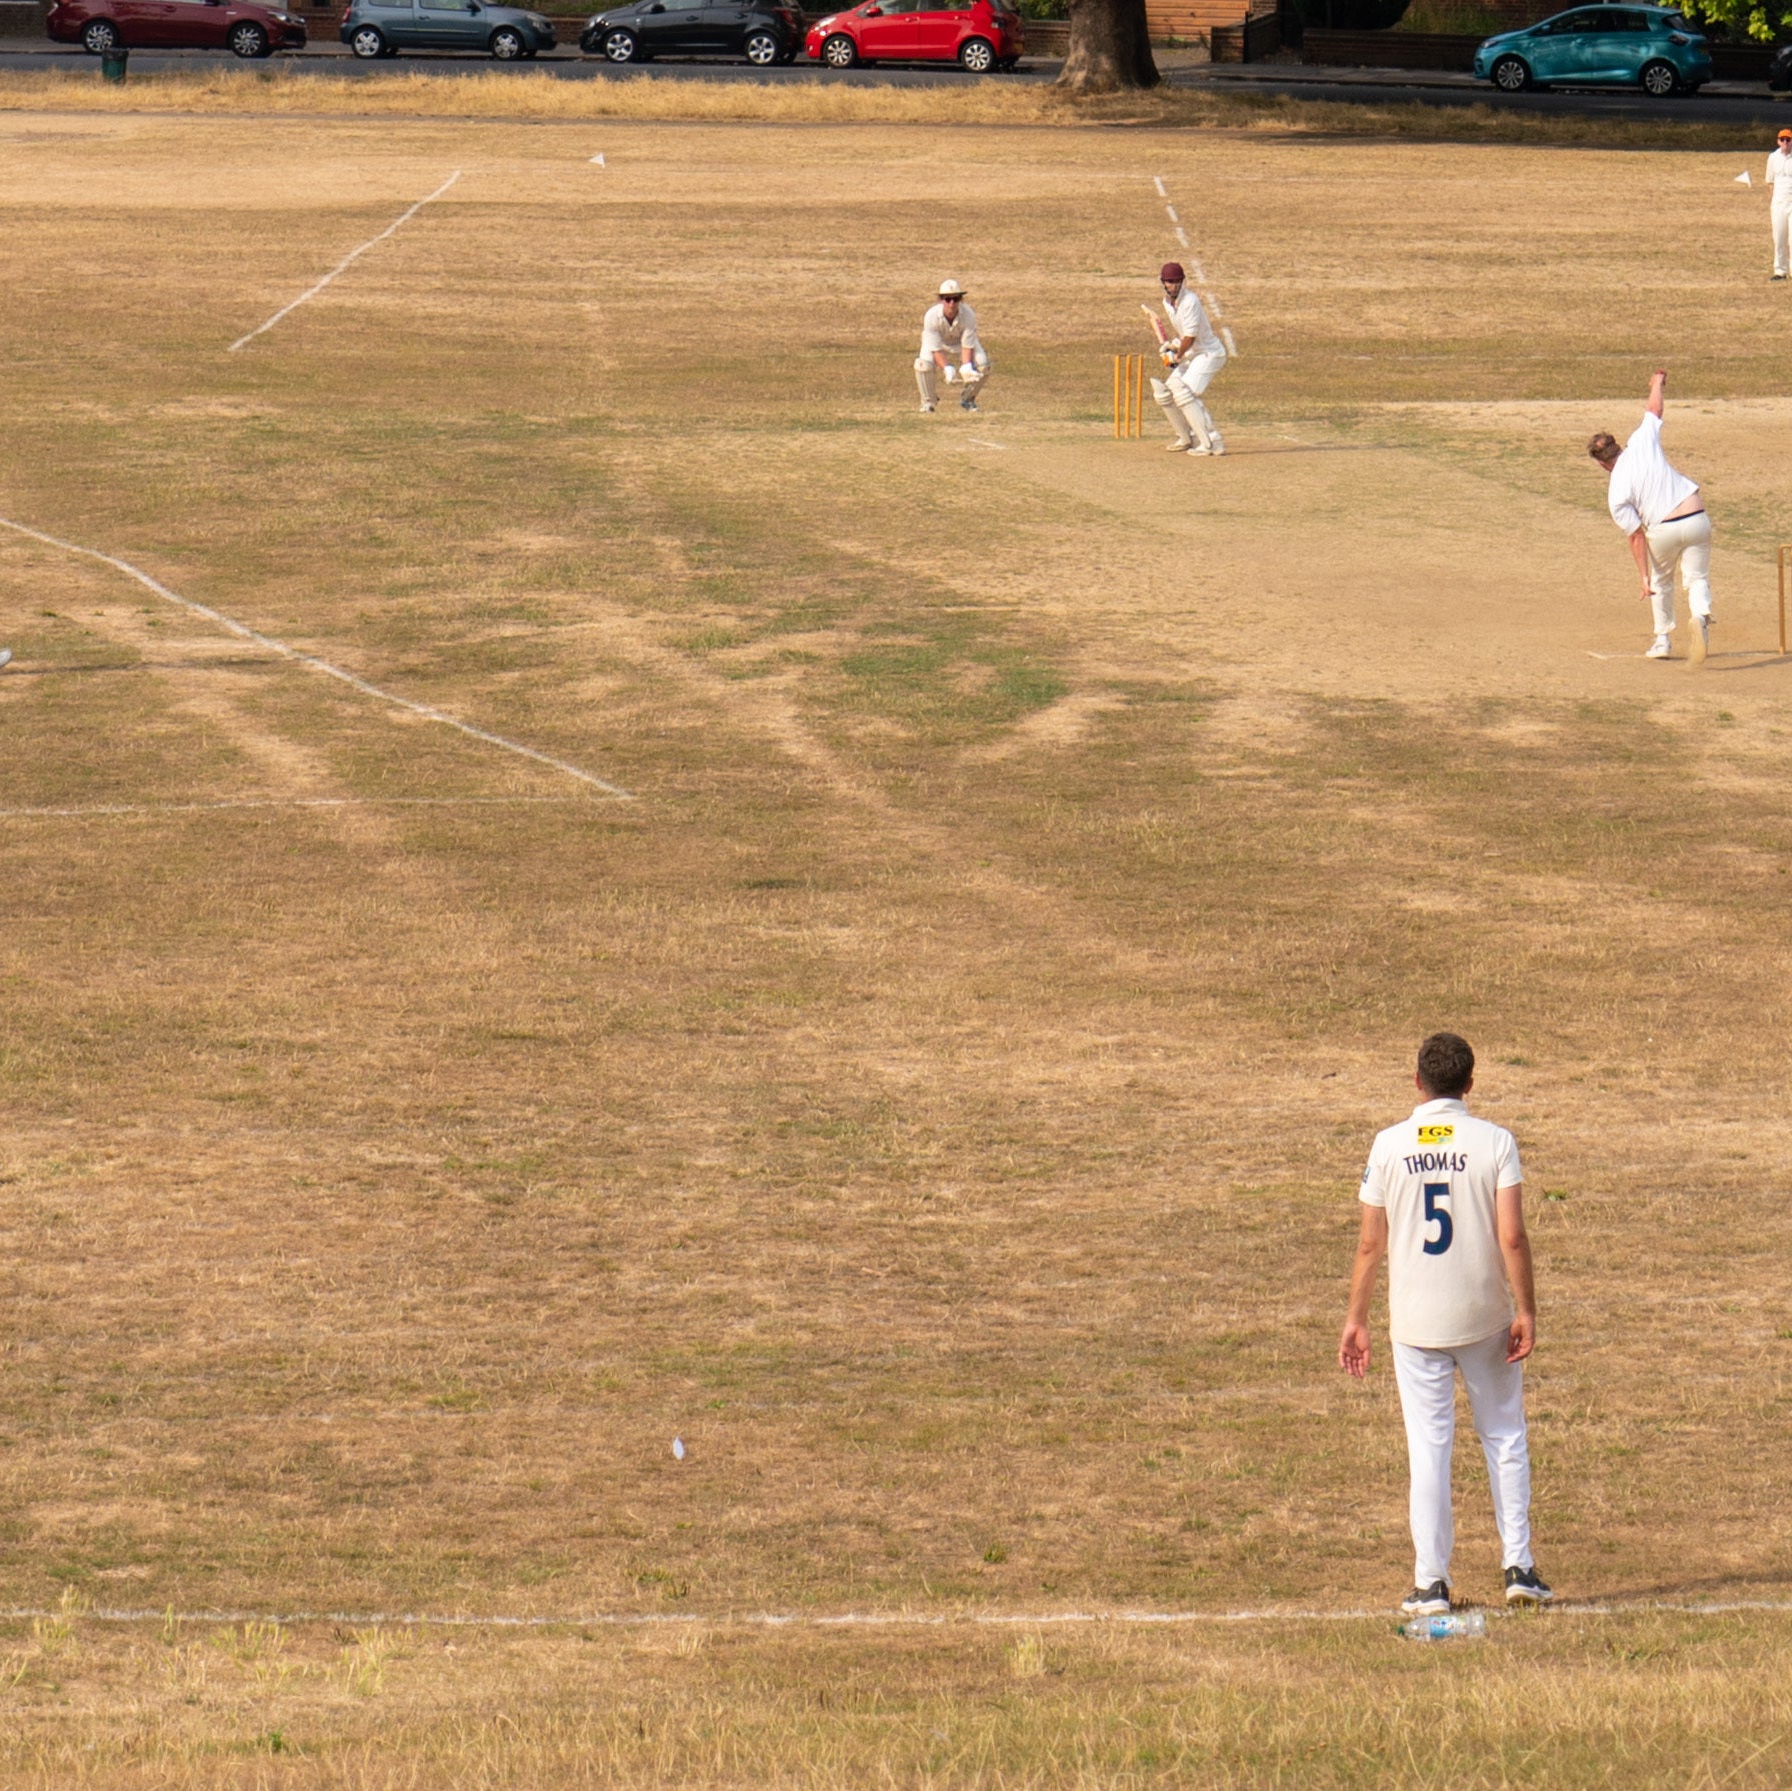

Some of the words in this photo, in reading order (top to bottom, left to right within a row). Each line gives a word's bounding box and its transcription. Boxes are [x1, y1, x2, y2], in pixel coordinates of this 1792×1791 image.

[1418, 1126, 1453, 1136] FGS
[1403, 1152, 1468, 1175] THOMAS
[1422, 1182, 1453, 1255] 5
